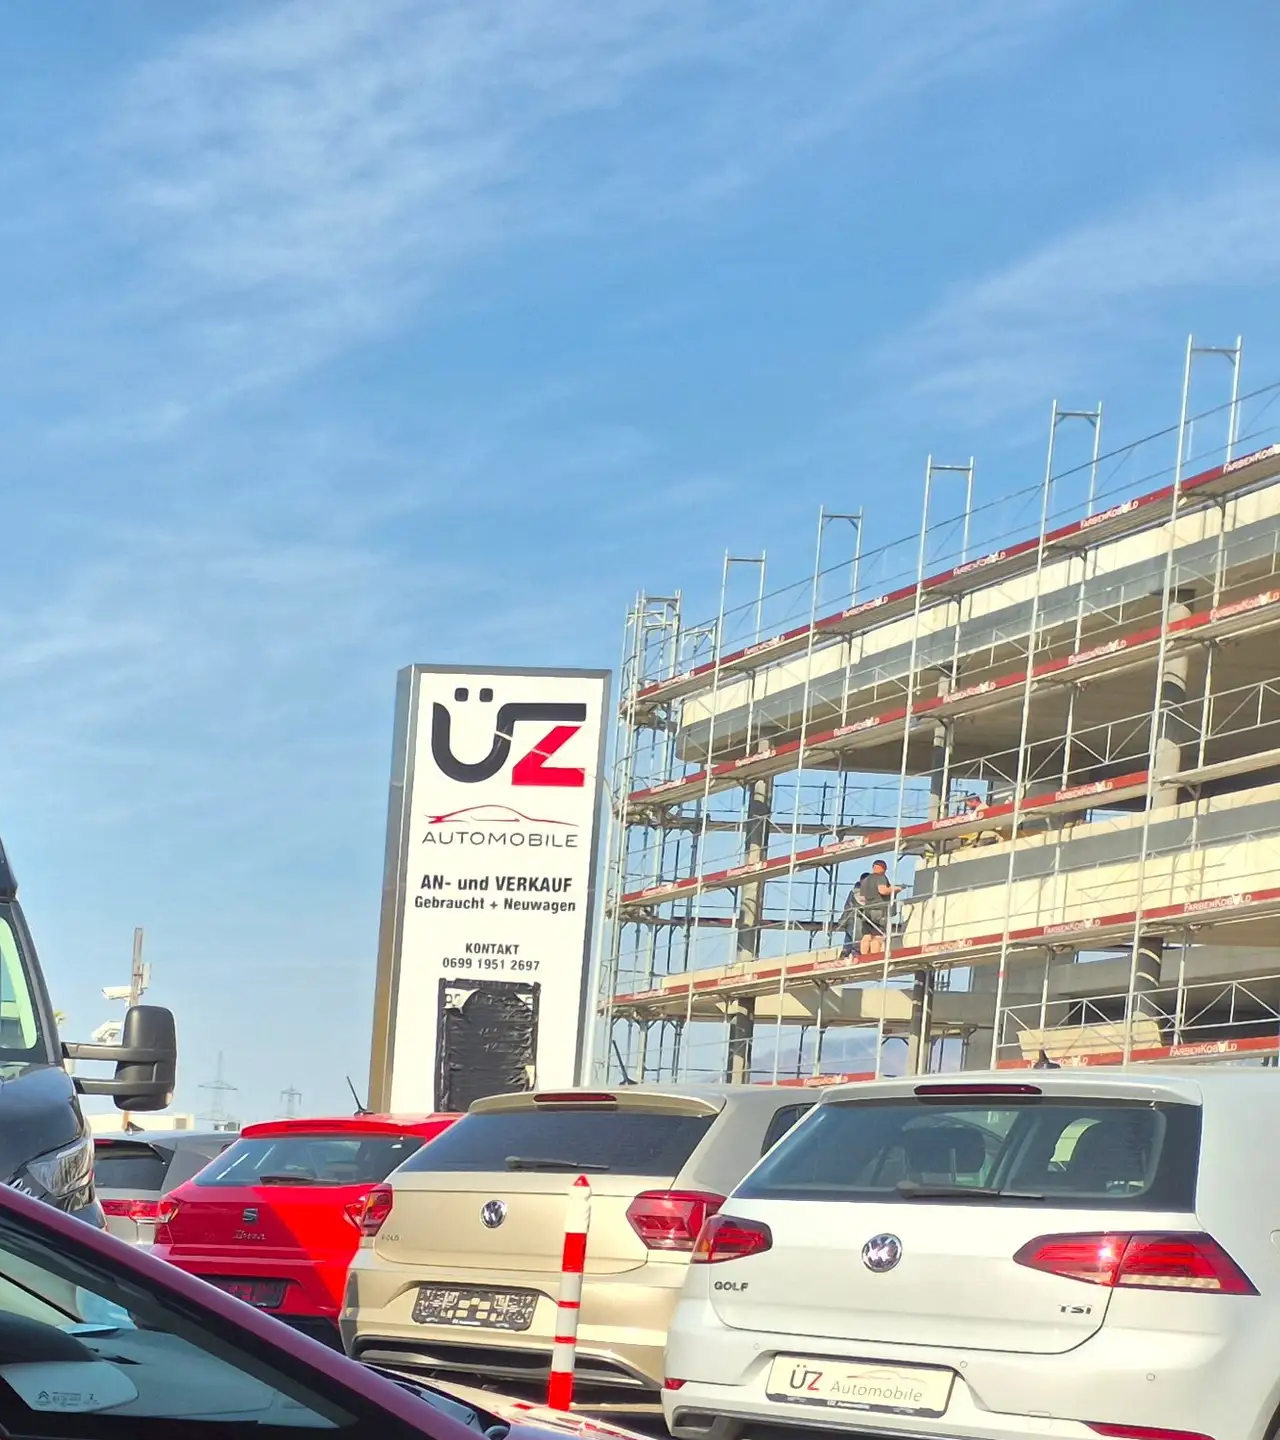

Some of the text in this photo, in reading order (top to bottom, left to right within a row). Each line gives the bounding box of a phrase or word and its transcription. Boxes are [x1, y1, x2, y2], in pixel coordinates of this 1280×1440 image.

[431, 687, 587, 787] ÜZ
[422, 831, 579, 847] AUTOMOBILE
[420, 874, 573, 892] AN- und VERKAUF
[414, 895, 576, 914] Gebraucht + Neuwagen
[465, 943, 520, 955] KONTAKT
[442, 957, 540, 971] 0699 1951 2697
[714, 1281, 749, 1292] GOLF
[789, 1364, 923, 1403] ÜZ Automobile
